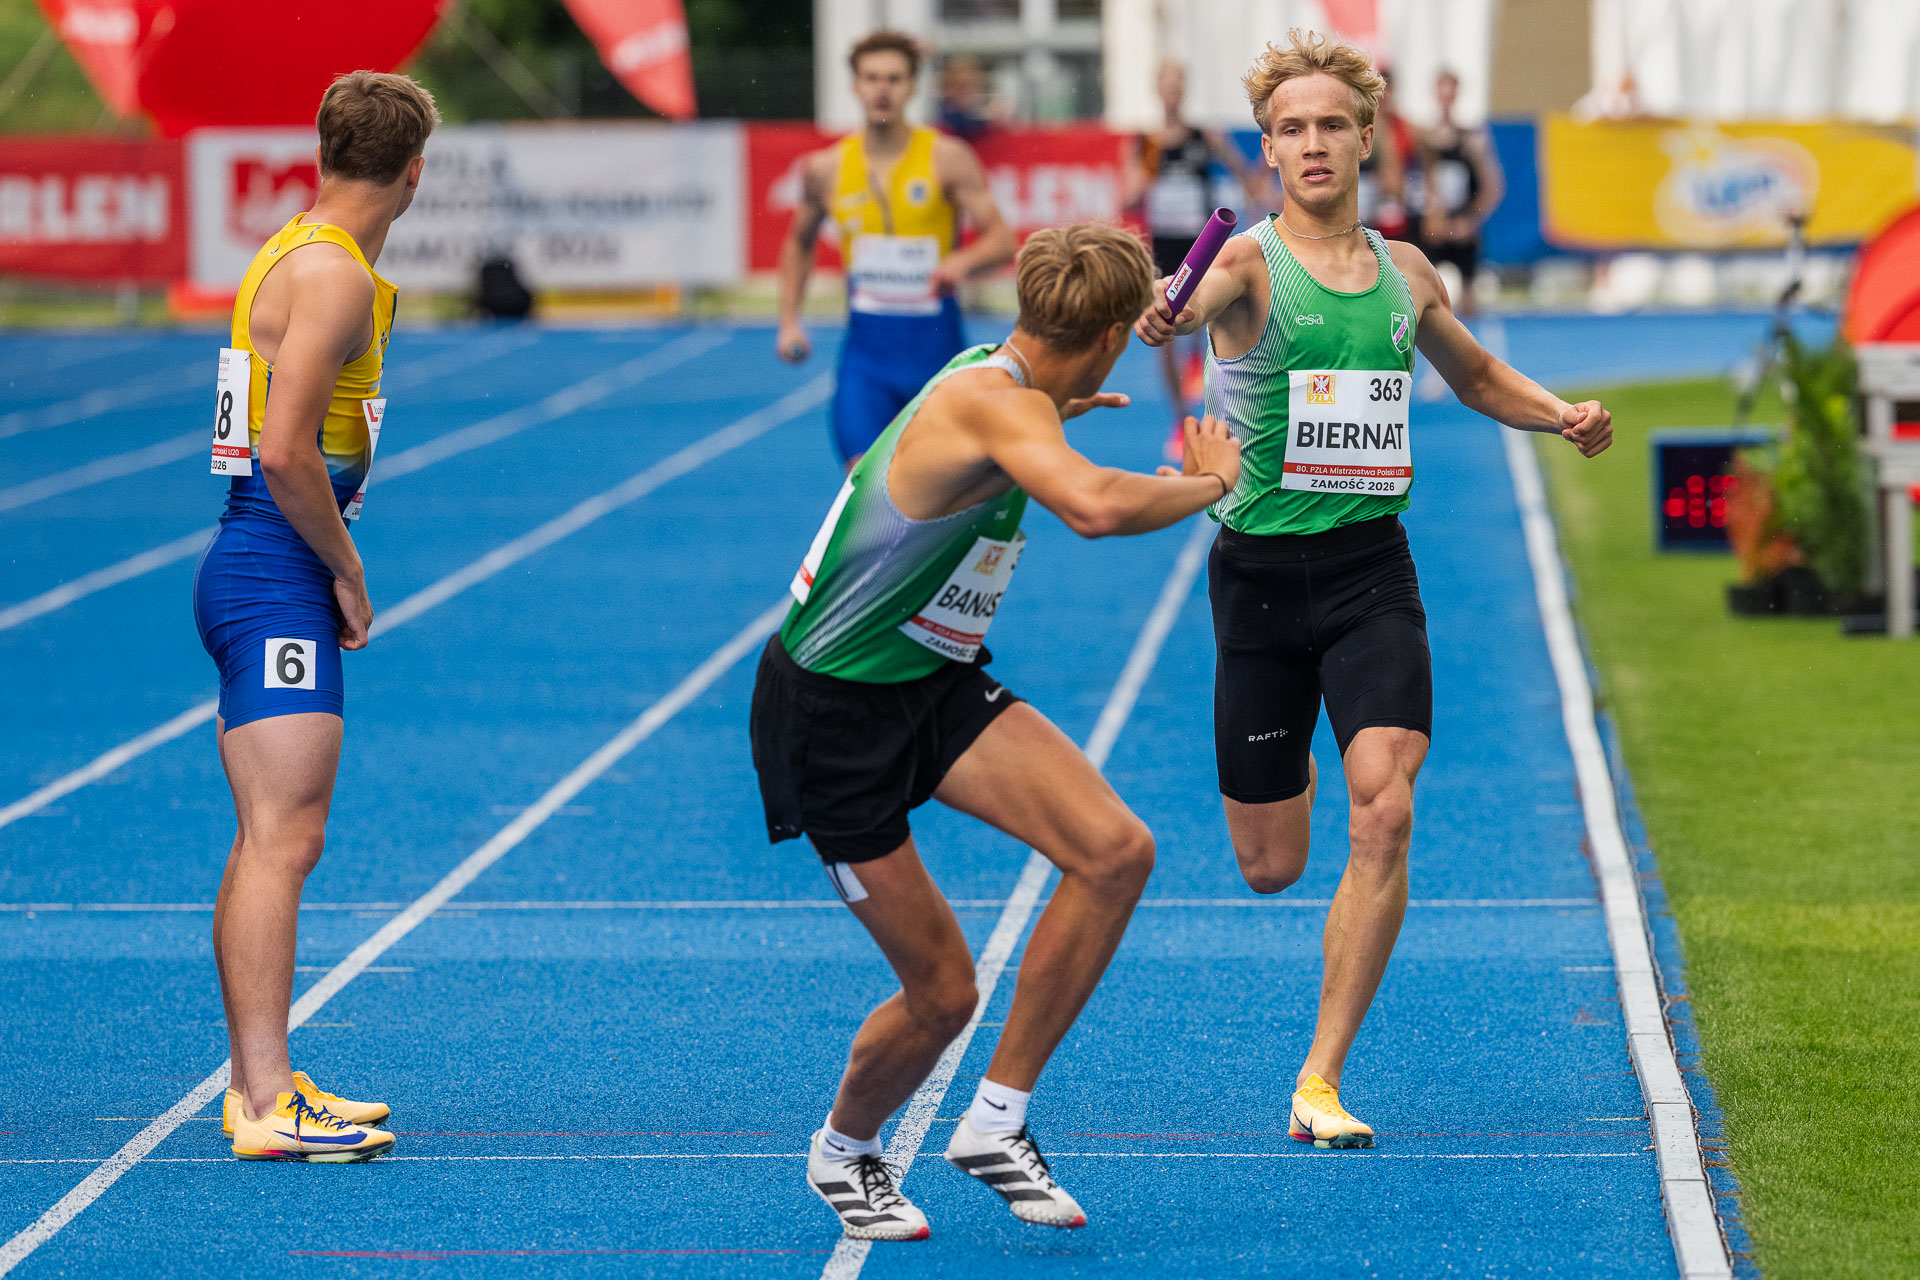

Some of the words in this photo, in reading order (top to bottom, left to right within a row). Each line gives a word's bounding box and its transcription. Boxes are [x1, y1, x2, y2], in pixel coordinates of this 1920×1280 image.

[1295, 314, 1324, 326] esa
[1369, 378, 1403, 402] 363
[1297, 422, 1403, 450] BIERNAT
[227, 448, 240, 456] U20
[1296, 465, 1308, 473] 80.
[1310, 466, 1328, 474] PZLA
[1329, 467, 1376, 476] Mistrzostwa
[1377, 469, 1395, 477] Polski
[1310, 478, 1365, 490] ZAMOŚĆ
[1368, 481, 1395, 491] 2026
[276, 642, 306, 685] 6
